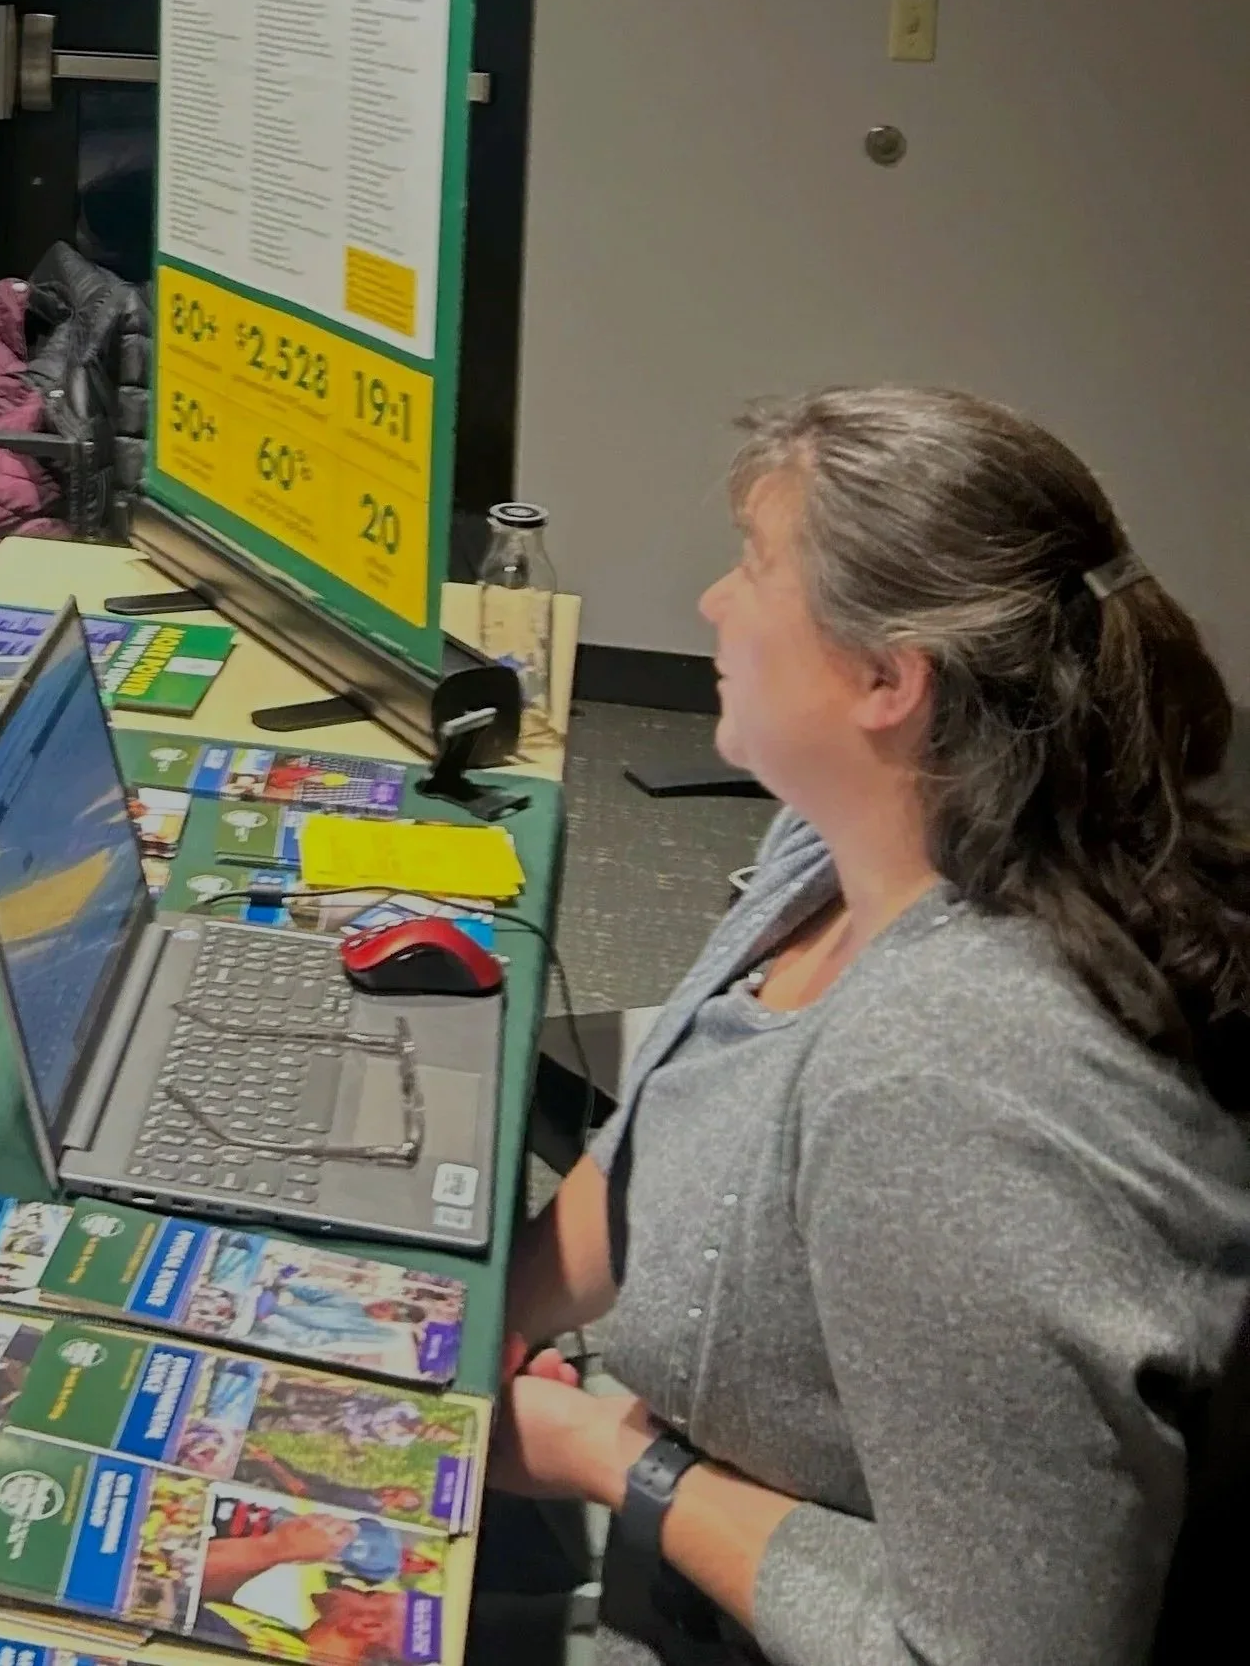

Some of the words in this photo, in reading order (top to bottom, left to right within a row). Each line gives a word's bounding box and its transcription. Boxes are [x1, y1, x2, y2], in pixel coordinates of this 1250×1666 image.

[171, 293, 218, 342] 80+
[353, 370, 411, 443] 19:1
[170, 390, 217, 442] 50+
[360, 493, 400, 554] 20
[116, 658, 167, 696] POWER
[141, 627, 188, 660] MORE
